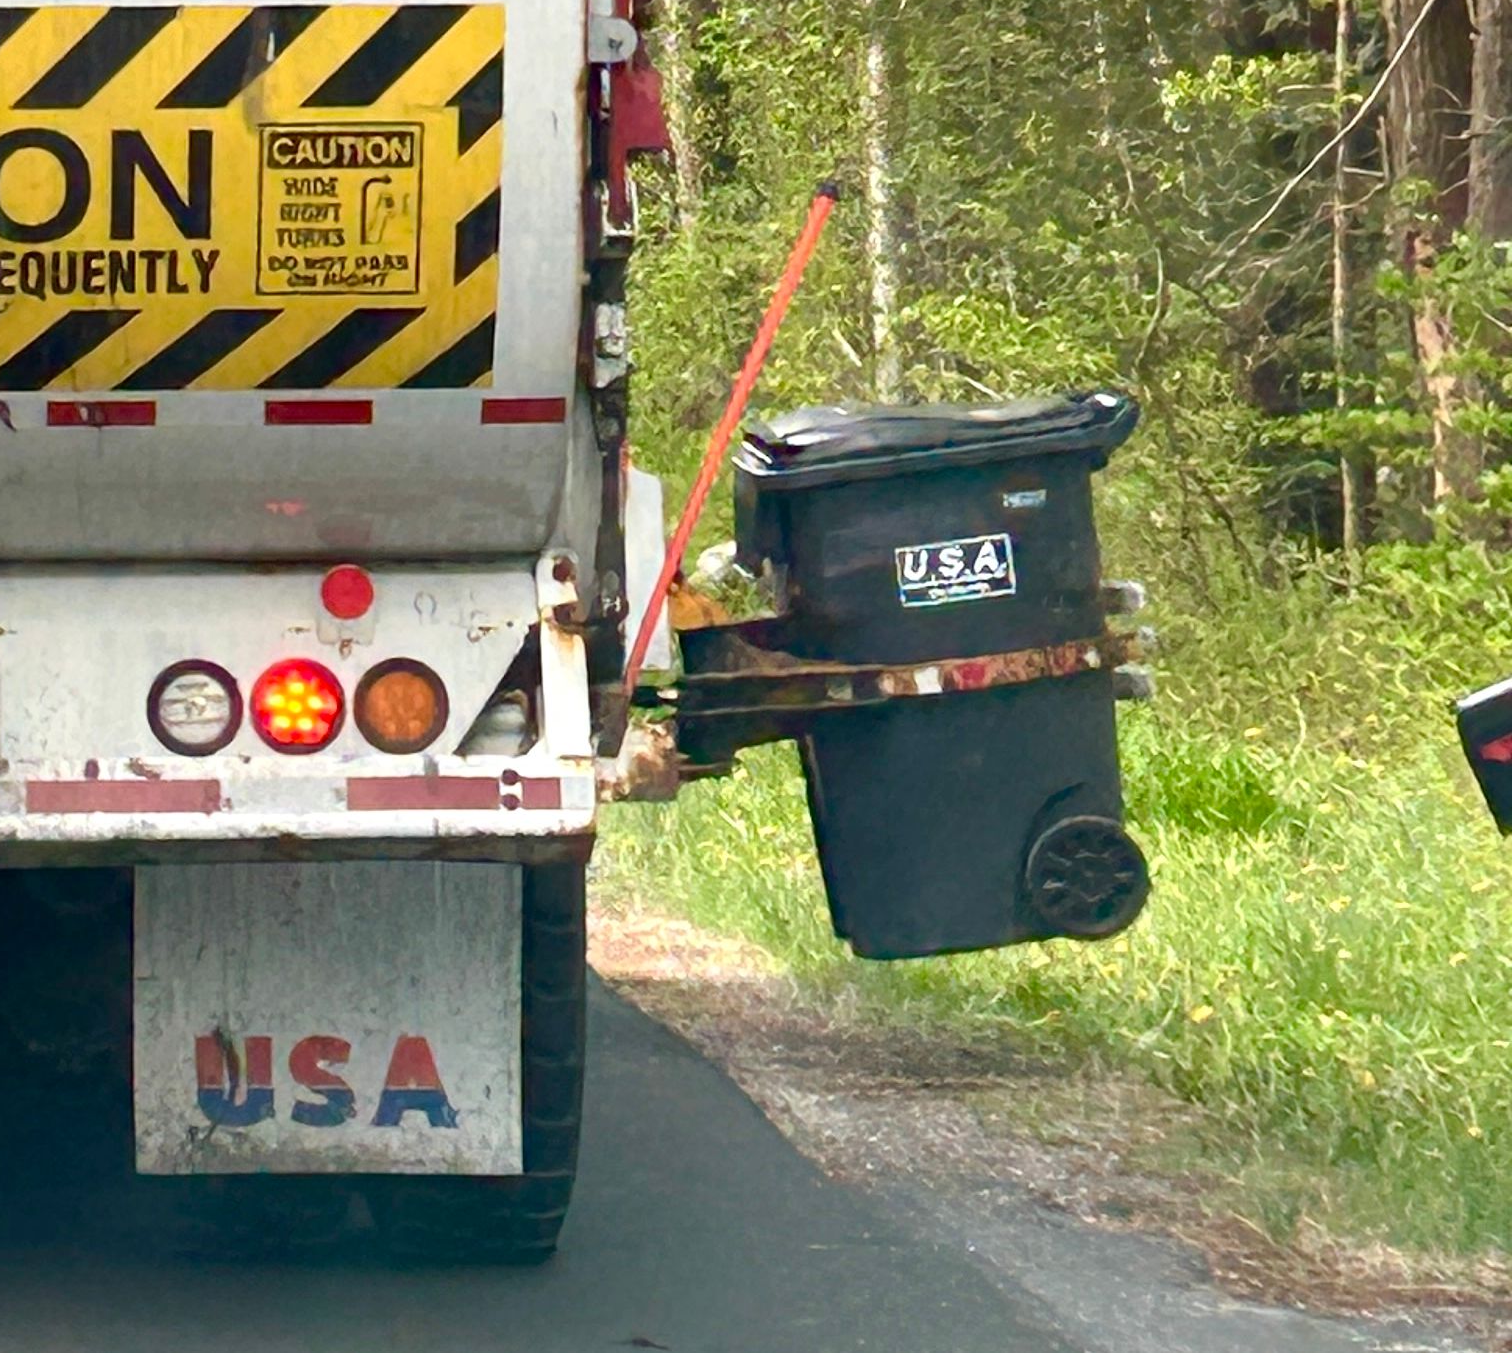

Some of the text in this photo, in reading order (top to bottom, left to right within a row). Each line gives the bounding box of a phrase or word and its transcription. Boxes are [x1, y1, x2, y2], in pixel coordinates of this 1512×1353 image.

[272, 135, 412, 165] CAUTION
[903, 540, 1001, 582] USA
[194, 1034, 460, 1128] USA
